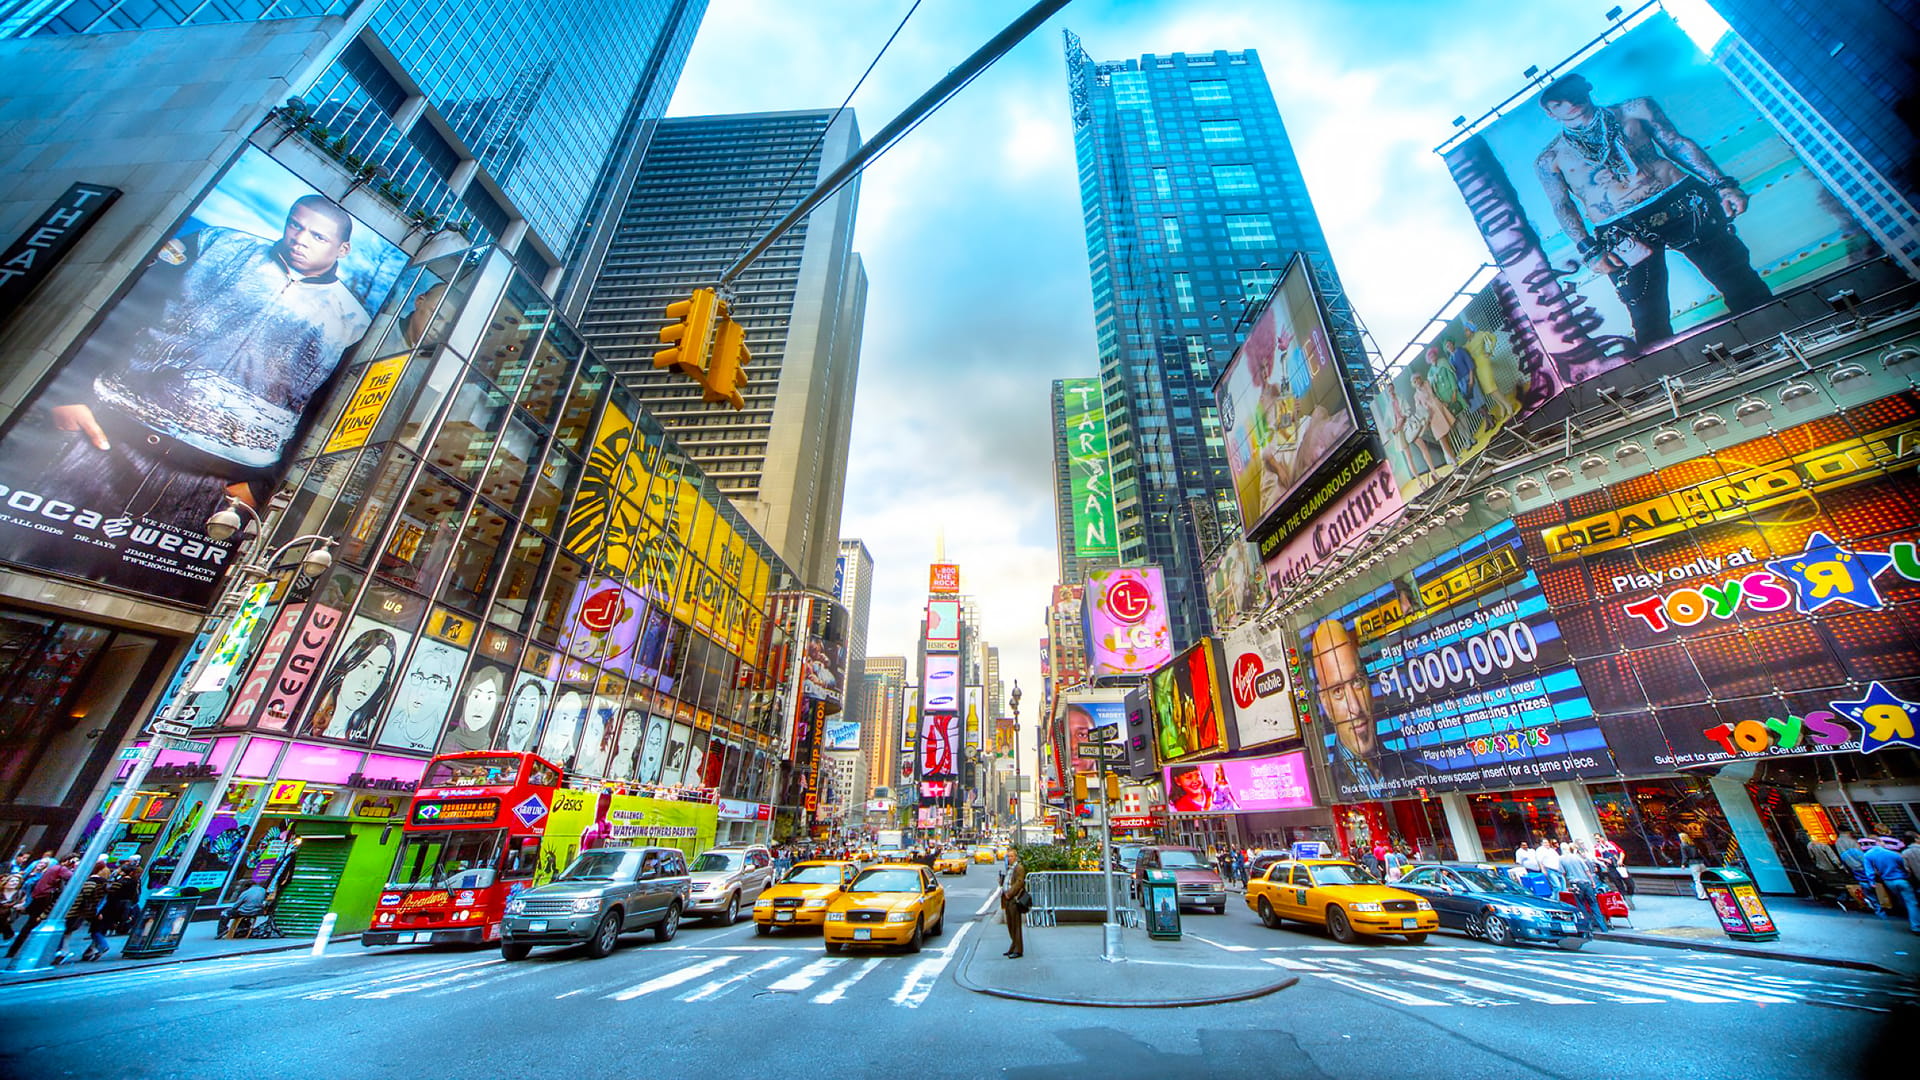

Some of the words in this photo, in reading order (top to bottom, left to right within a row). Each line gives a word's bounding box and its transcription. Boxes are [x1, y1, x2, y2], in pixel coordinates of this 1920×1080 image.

[368, 372, 392, 389] THE
[351, 388, 387, 415] LION
[337, 412, 375, 440] KING
[1070, 387, 1107, 547] TARZAN
[1261, 535, 1279, 556] BORN
[1279, 526, 1289, 541] IN
[1288, 514, 1301, 533] THE
[1300, 471, 1352, 520] GLAMOROUS
[1351, 449, 1374, 476] USA
[1311, 468, 1396, 557] Couture
[1555, 505, 1673, 552] DEAL
[1712, 468, 1802, 512] NO
[10, 518, 33, 529] ALL
[34, 523, 65, 536] ODDS
[73, 533, 91, 544] DR.
[142, 517, 157, 527] WE
[159, 521, 181, 534] RUN
[183, 528, 204, 541] THE
[1612, 570, 1664, 593] Play
[1668, 556, 1722, 580] only
[1723, 547, 1756, 569] at
[383, 599, 403, 614] we
[1360, 606, 1403, 635] DEAL
[1449, 549, 1518, 595] DEAL
[1624, 572, 1791, 632] TOYS
[1113, 626, 1151, 649] LG
[1382, 641, 1403, 660] Play
[1403, 635, 1419, 652] for
[1420, 634, 1429, 646] a
[1431, 618, 1473, 642] chance
[1474, 609, 1490, 624] to
[1491, 600, 1519, 618] win
[927, 641, 947, 650] HSBC
[1378, 621, 1538, 701] $1,000,000
[1258, 676, 1283, 694] mobile
[1399, 712, 1408, 722] or
[1416, 705, 1432, 720] trip
[1433, 702, 1443, 713] to
[1496, 687, 1508, 699] or
[1512, 680, 1536, 696] over
[1400, 721, 1436, 737] 100,000
[1437, 713, 1461, 729] other
[1463, 703, 1509, 724] amazing
[1511, 694, 1551, 718] prizes!
[814, 701, 826, 746] KODAK
[1703, 710, 1852, 756] TOYS
[1424, 749, 1440, 761] Play
[1440, 747, 1456, 759] only
[1457, 745, 1466, 755] at
[1466, 737, 1506, 757] TOYS
[1526, 727, 1550, 747] US
[1438, 768, 1481, 785] newspaper
[1481, 765, 1506, 779] insert
[1508, 764, 1521, 777] for
[1523, 763, 1530, 774] a
[1531, 758, 1561, 777] game
[1562, 755, 1598, 772] piece.
[1654, 753, 1692, 765] Subject
[1694, 751, 1706, 762] to
[613, 825, 648, 837] WATCHING
[649, 826, 672, 837] OTHERS
[672, 827, 686, 837] PASS
[686, 827, 698, 837] YOU
